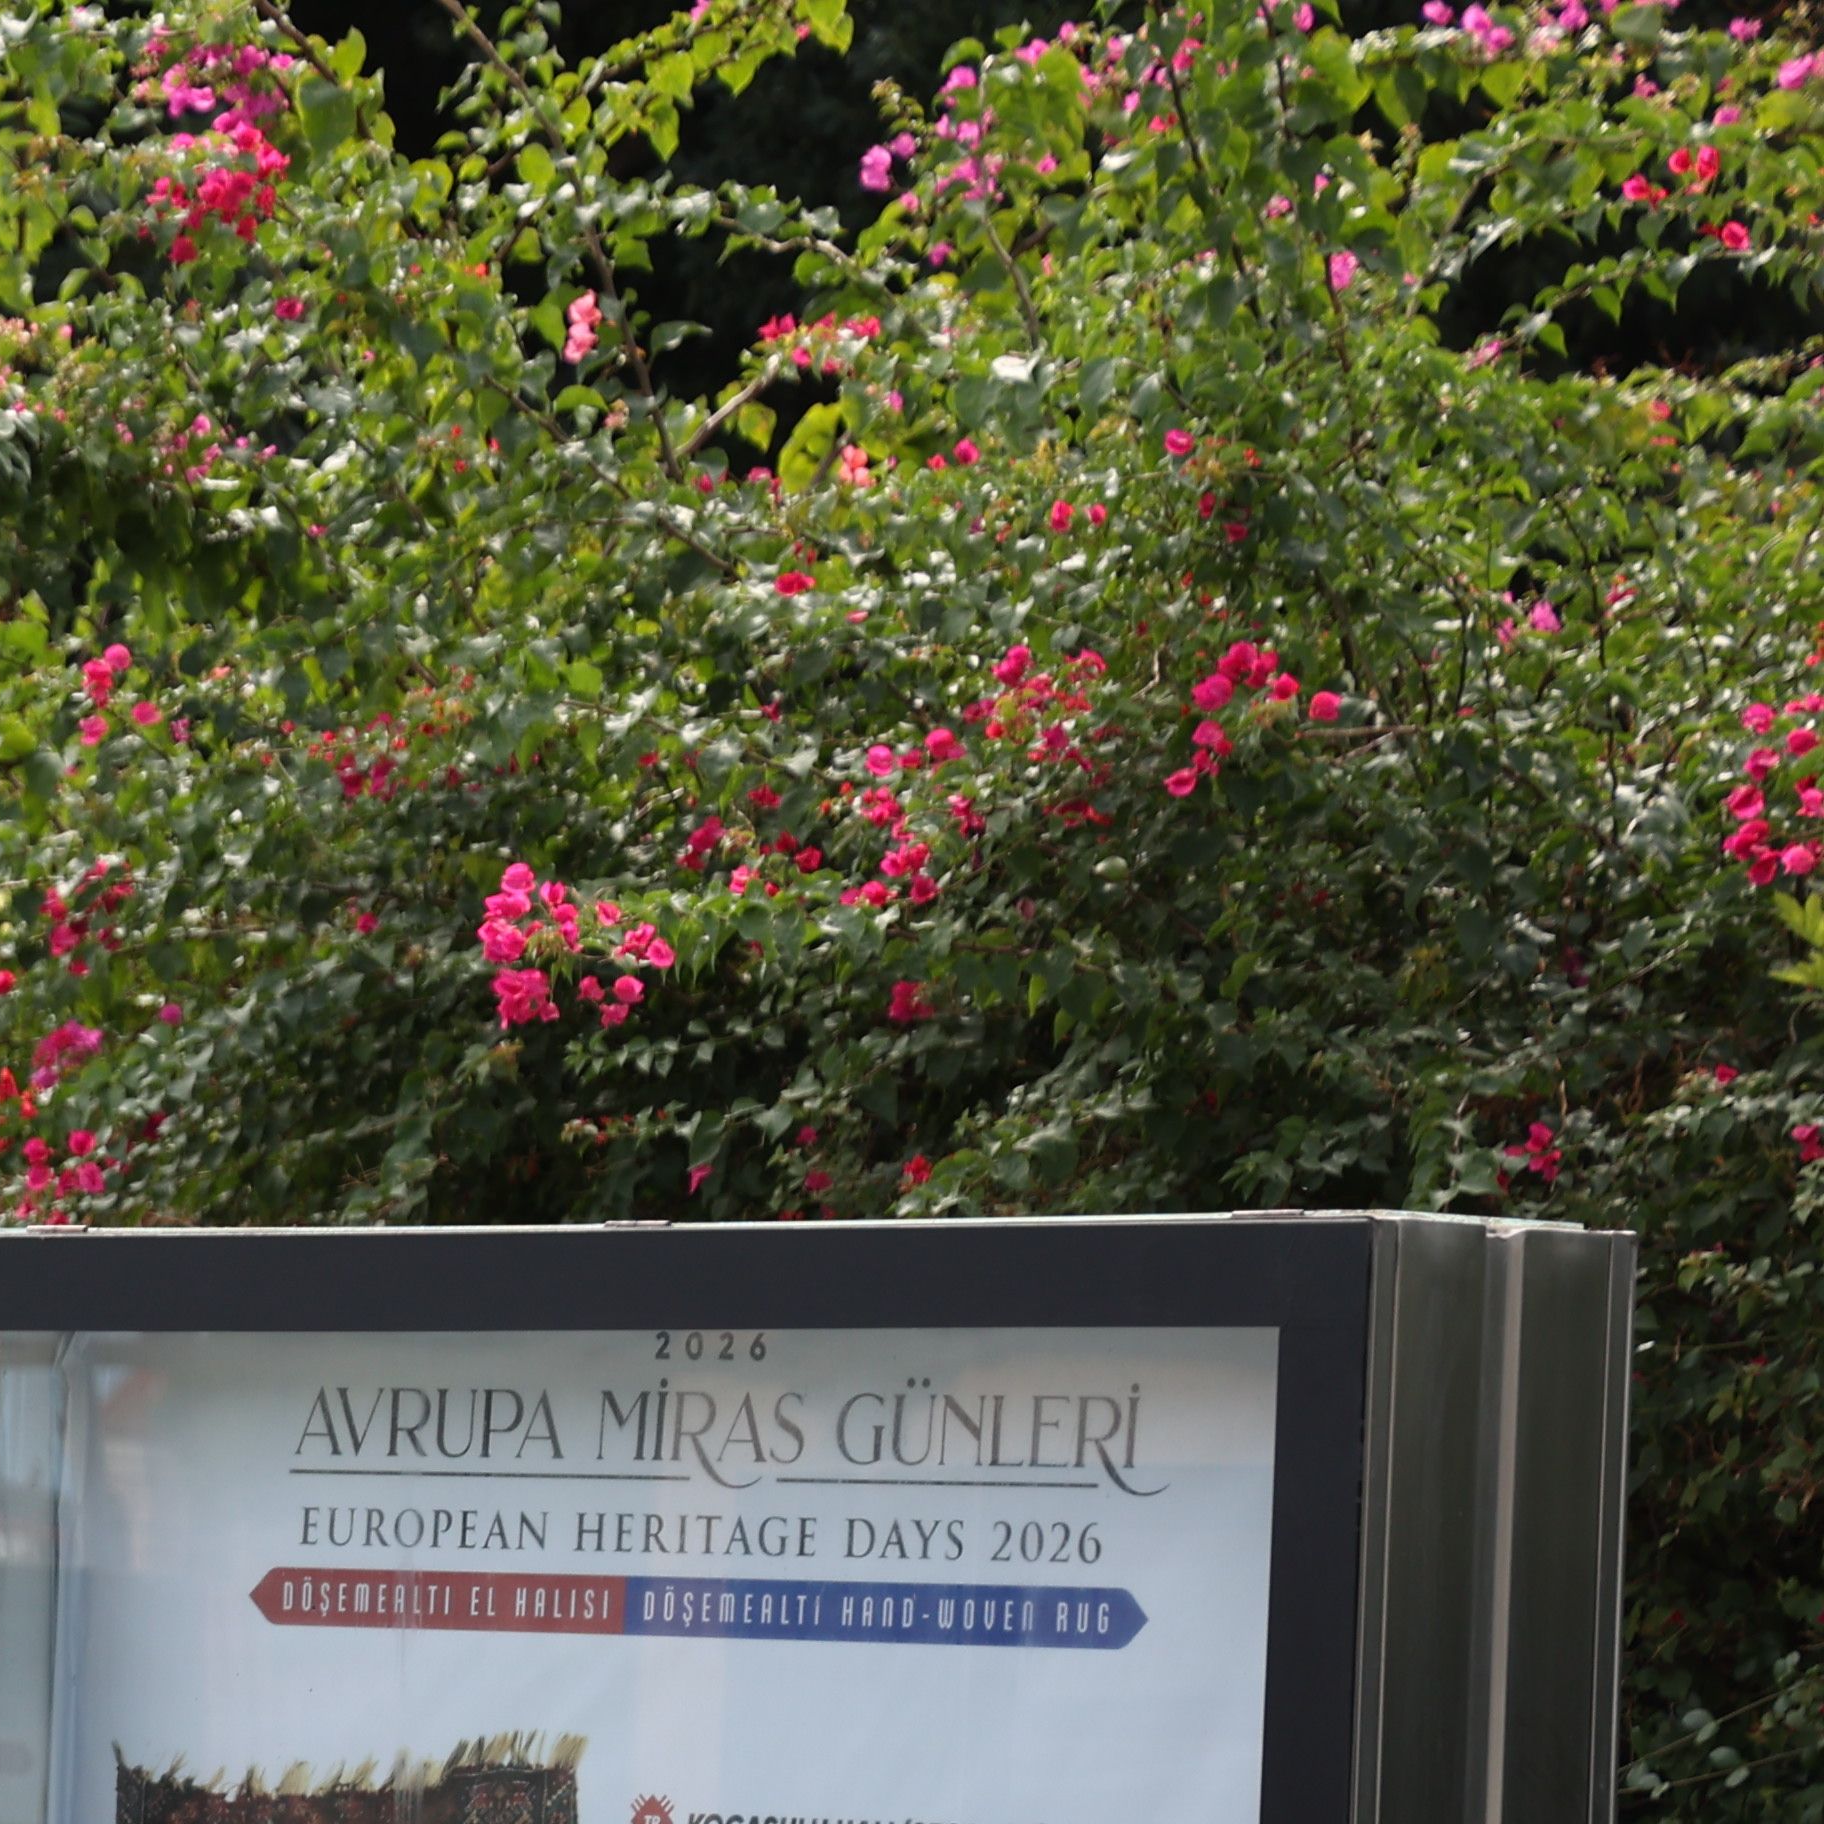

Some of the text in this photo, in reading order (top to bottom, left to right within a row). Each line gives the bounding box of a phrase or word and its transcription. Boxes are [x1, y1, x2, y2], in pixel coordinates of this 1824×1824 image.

[655, 1332, 766, 1361] 2026
[295, 1377, 1170, 1496] AVRUPA MİRAS GÜNLERİ
[299, 1507, 1102, 1563] EUROPEAN HERITAGE DAYS 2026
[283, 1576, 608, 1619] DÖŞEMEALTI EL HALISI
[644, 1586, 1109, 1633] DÖŞEMEALTI HAND-WOVEN RUG
